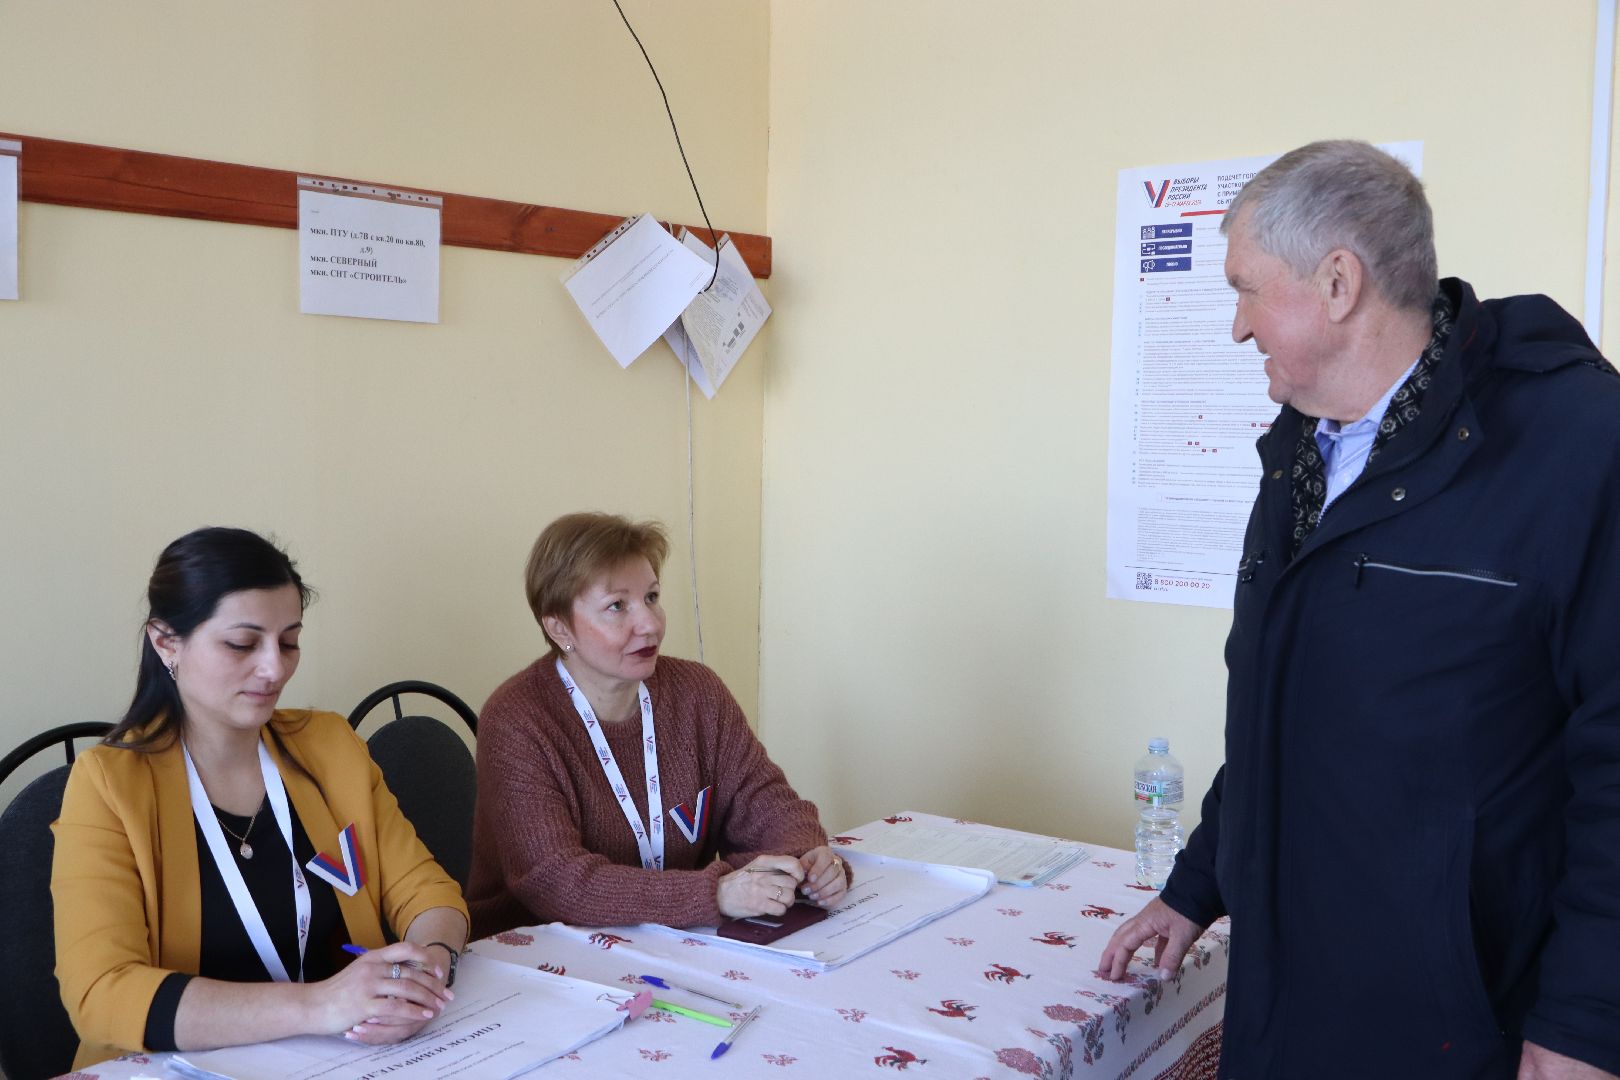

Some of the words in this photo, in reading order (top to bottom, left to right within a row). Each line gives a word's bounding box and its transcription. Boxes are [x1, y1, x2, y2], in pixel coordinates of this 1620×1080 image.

[1173, 177, 1200, 185] ВЫБОРЫ
[1170, 183, 1208, 193] ПРЕЗИДЕНТА
[1168, 192, 1192, 201] РОССИИ
[330, 228, 349, 238] ПТУ
[330, 255, 377, 268] СЕВЕРНЫЙ
[330, 269, 348, 278] СНТ
[349, 271, 407, 284] «СТРОИТЕЛЬ»
[1175, 580, 1189, 588] 200
[447, 1023, 502, 1048] СПИСОК
[358, 1046, 448, 1080] ИЗБИРАТЕЛЕ
